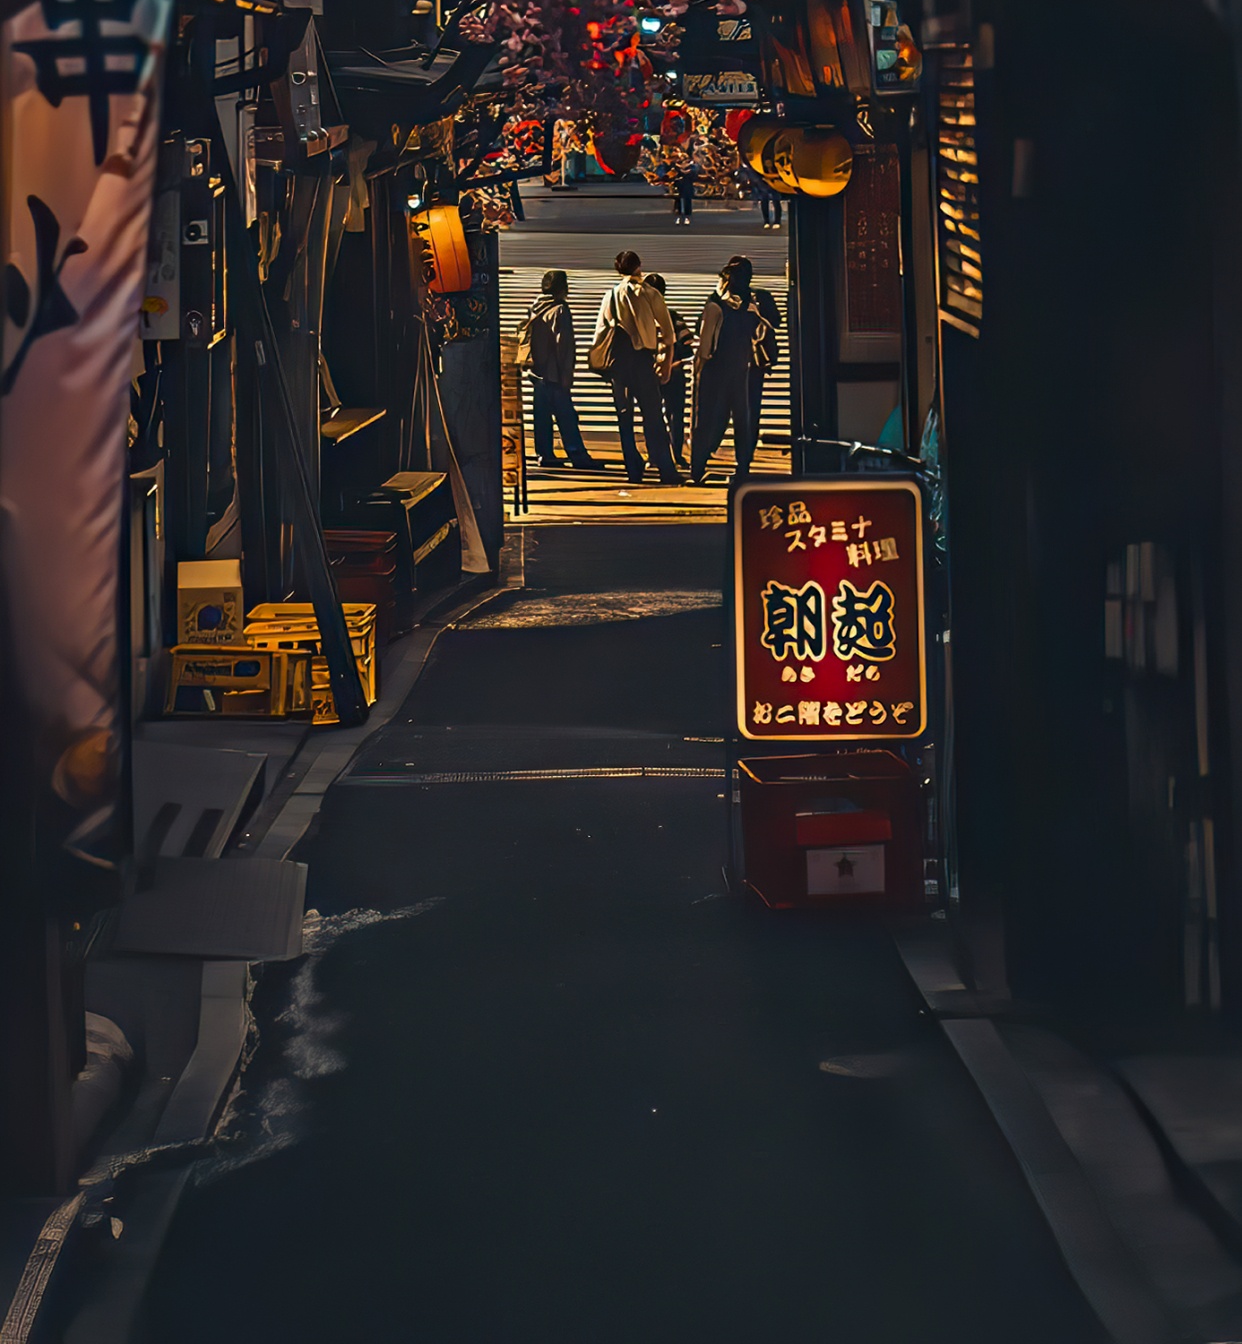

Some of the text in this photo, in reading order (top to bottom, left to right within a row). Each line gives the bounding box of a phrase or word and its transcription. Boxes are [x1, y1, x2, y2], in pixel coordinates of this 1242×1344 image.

[784, 515, 872, 553] スタミナ
[845, 537, 899, 568] 料理
[761, 579, 897, 662] 朝起
